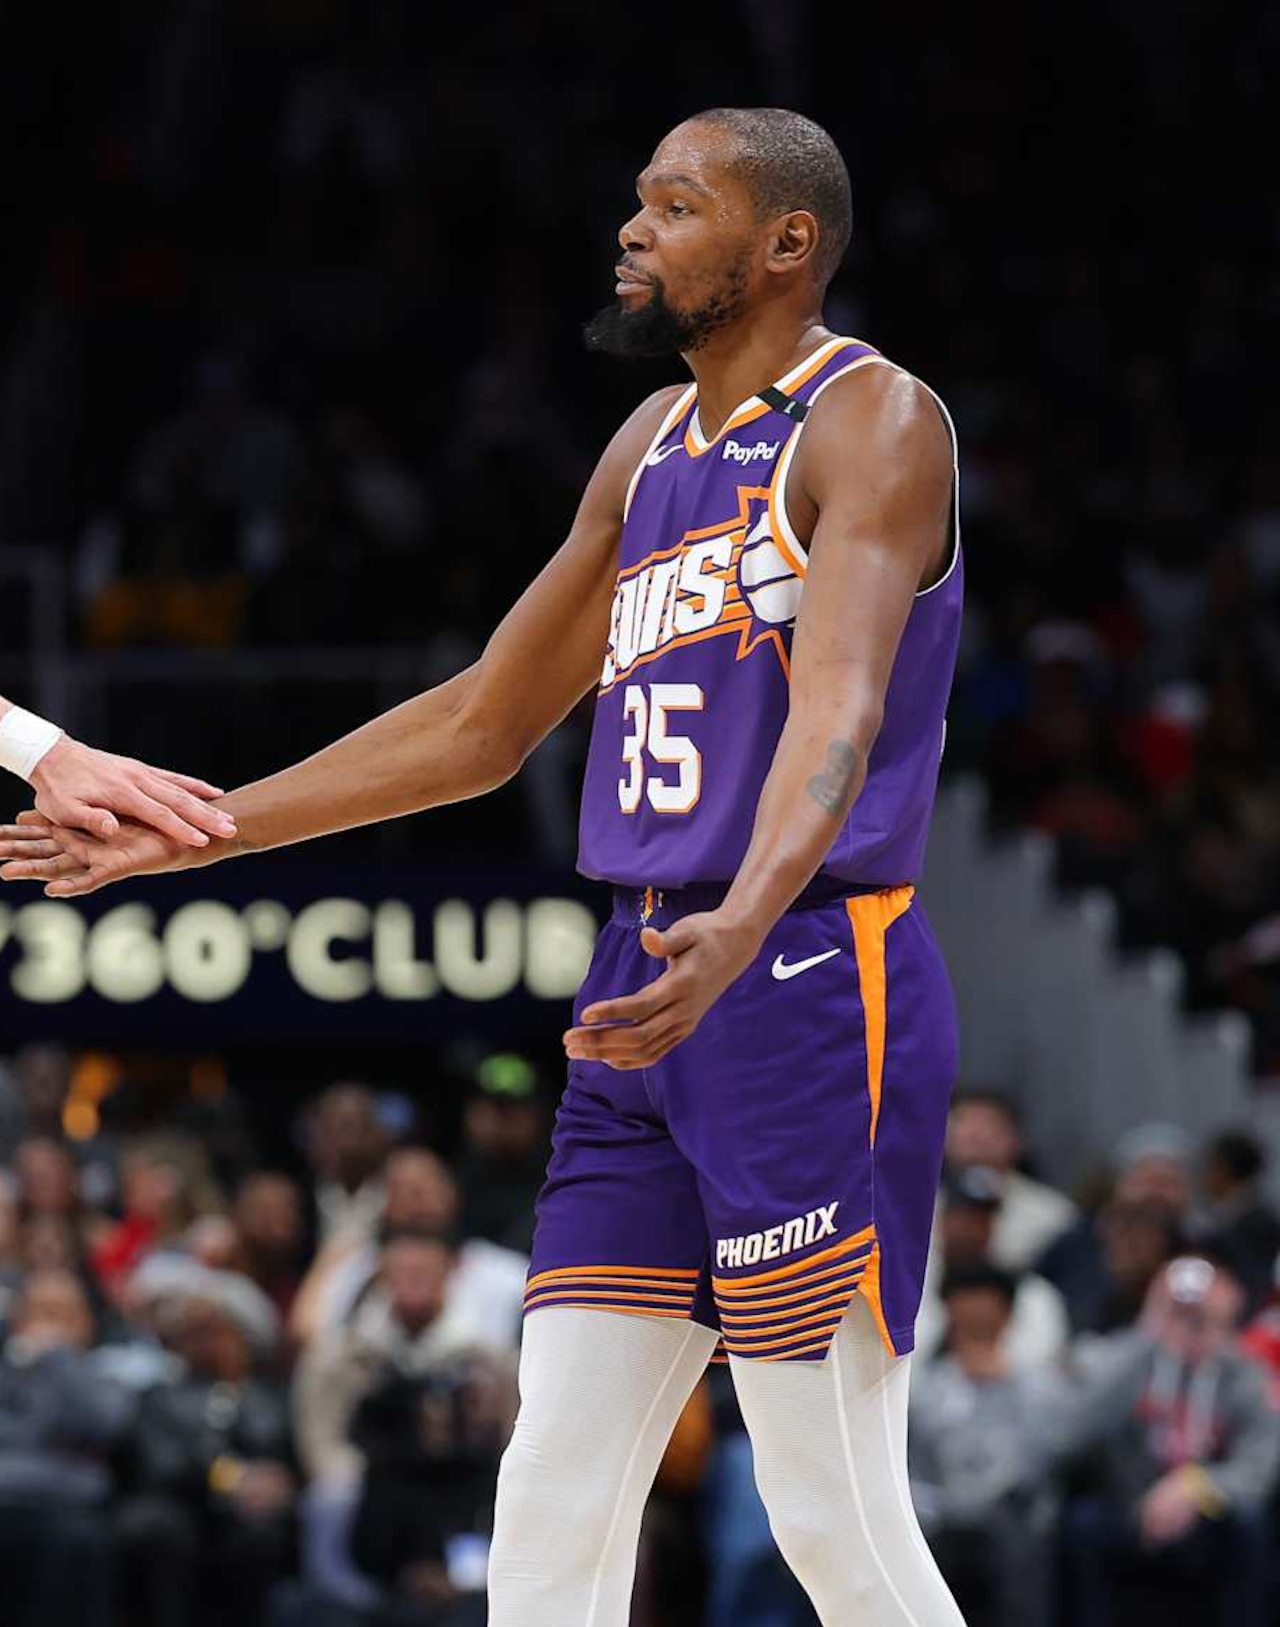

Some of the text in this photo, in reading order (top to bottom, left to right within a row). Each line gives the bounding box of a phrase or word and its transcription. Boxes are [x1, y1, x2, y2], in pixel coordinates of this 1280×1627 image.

[722, 440, 780, 466] PayPal
[618, 683, 704, 814] 35
[716, 1201, 839, 1268] PHOENIX
